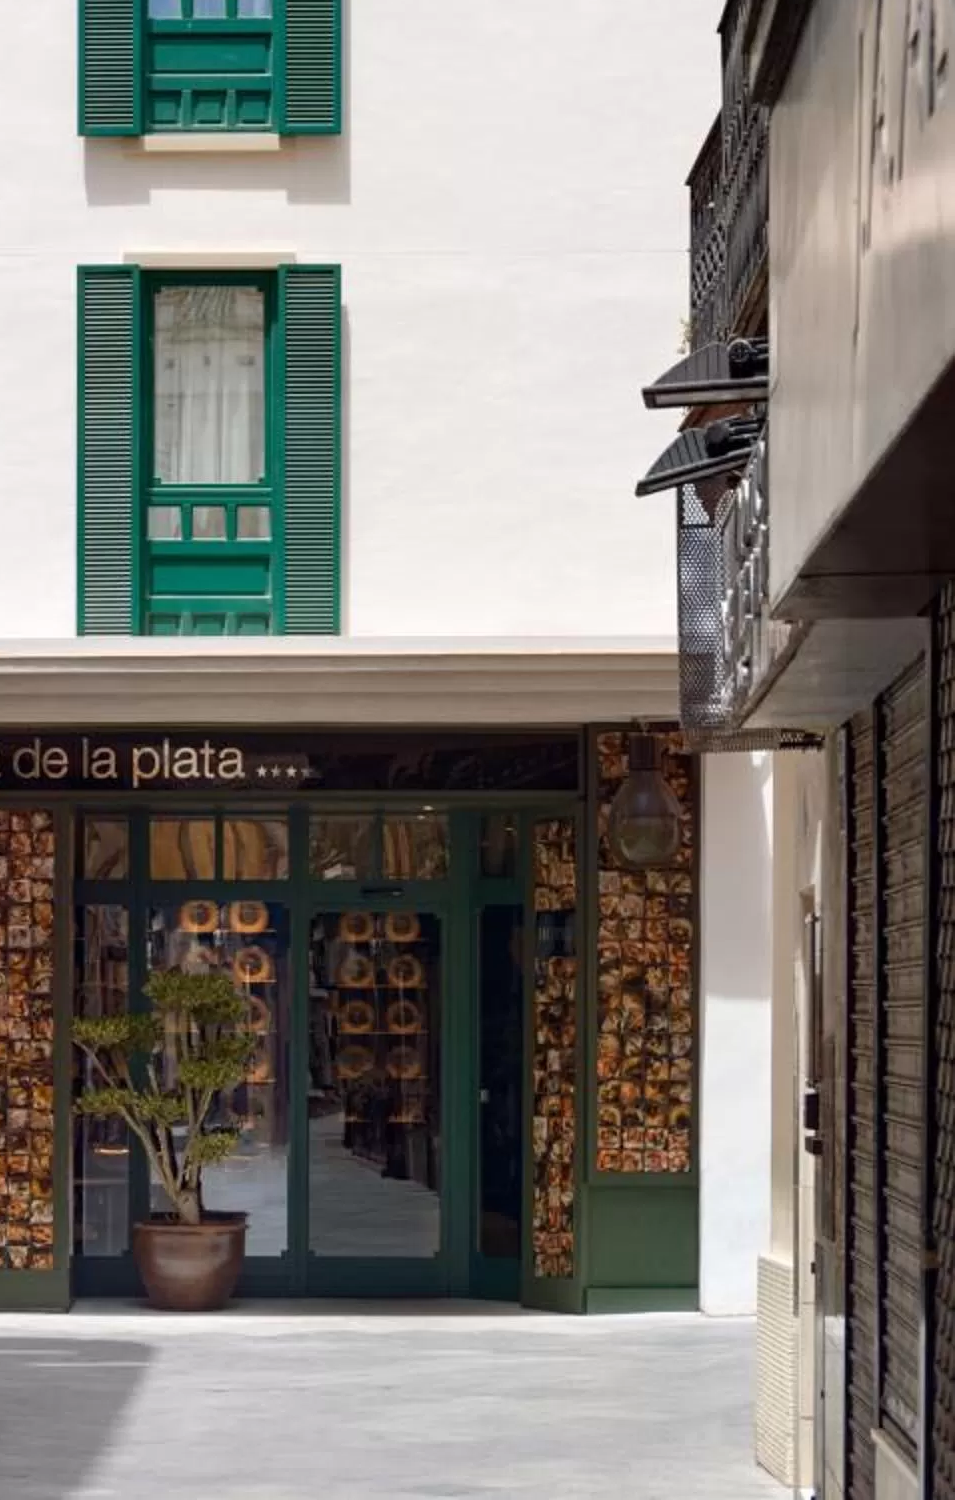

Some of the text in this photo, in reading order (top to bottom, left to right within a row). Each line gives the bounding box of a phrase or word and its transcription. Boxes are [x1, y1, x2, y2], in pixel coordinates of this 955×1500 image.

[12, 737, 70, 780] de
[81, 738, 119, 780] la
[132, 738, 247, 788] plata
